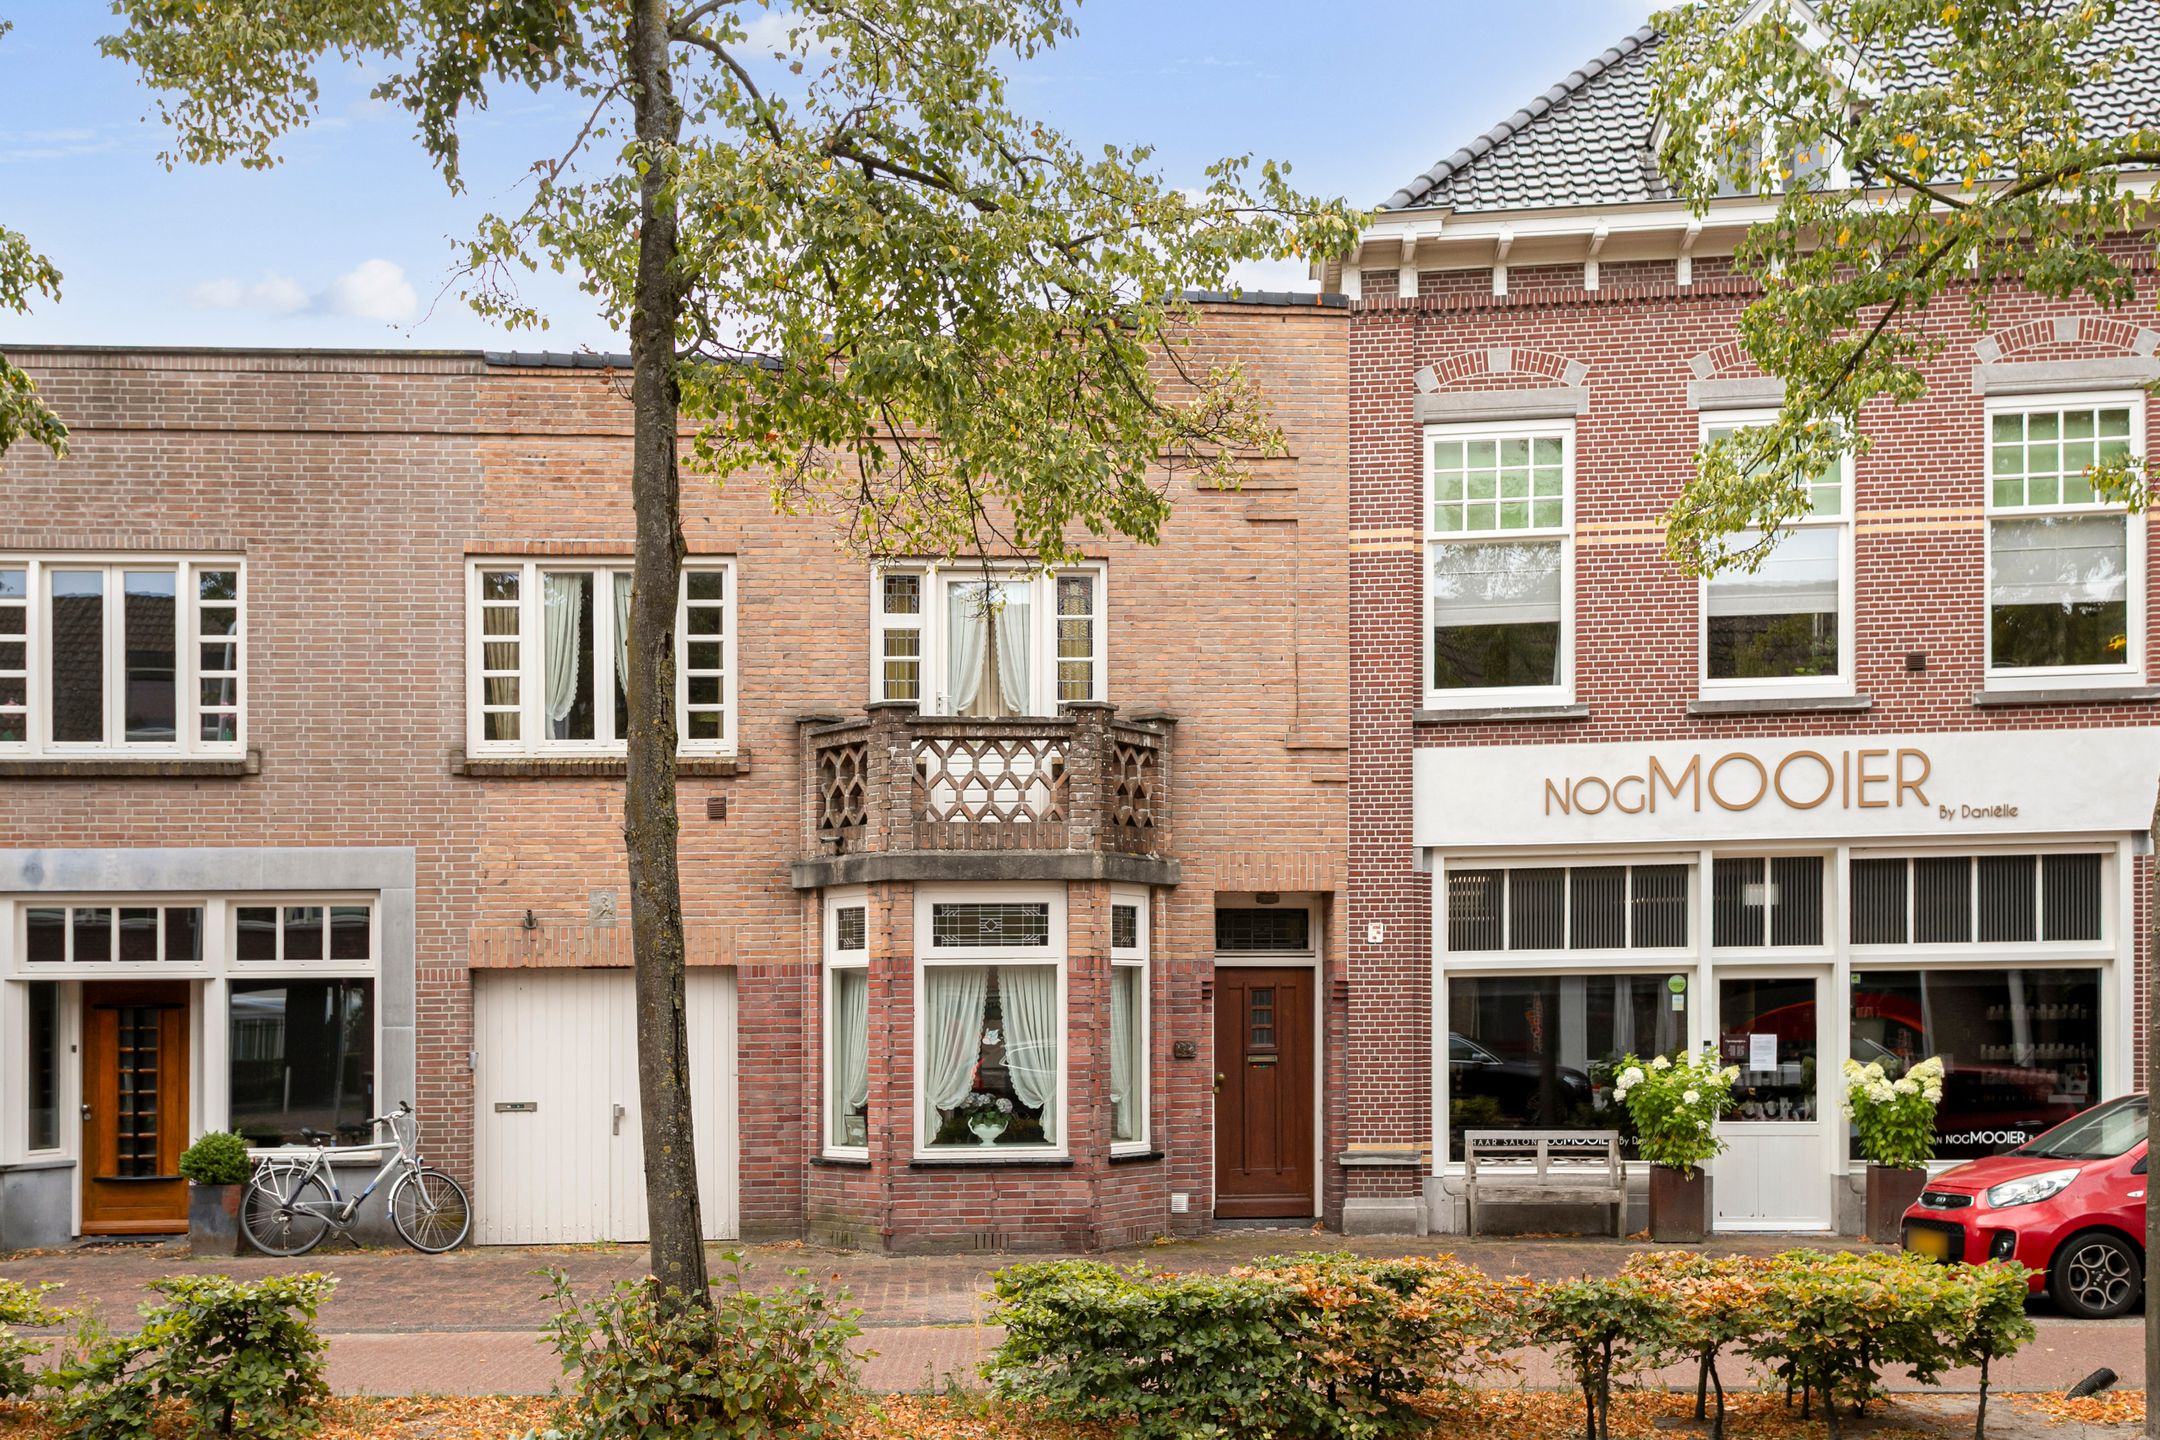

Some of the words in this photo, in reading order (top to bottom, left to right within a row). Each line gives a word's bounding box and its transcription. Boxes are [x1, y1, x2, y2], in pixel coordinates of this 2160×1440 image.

[1939, 804, 1956, 821] By
[1503, 1138, 1537, 1146] SALON
[1619, 1135, 1630, 1147] By
[1945, 1131, 2026, 1144] NOGMOOIER
